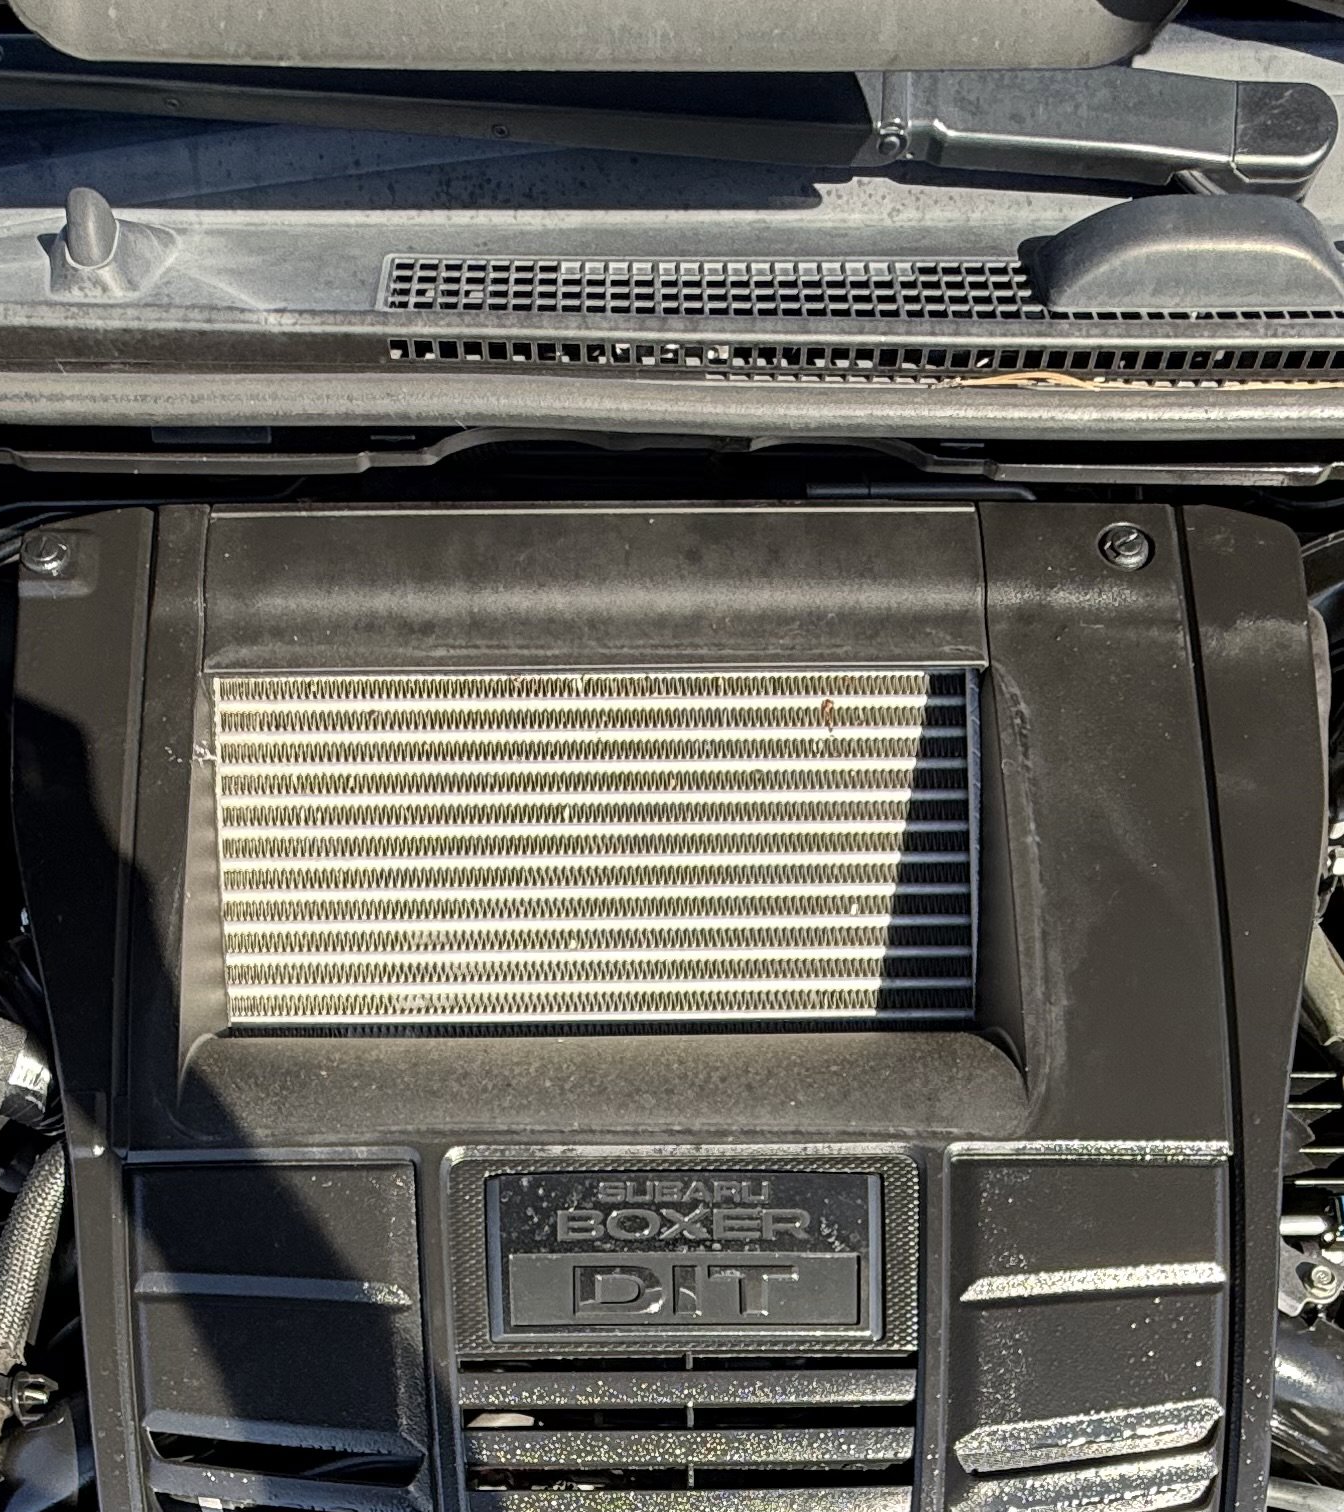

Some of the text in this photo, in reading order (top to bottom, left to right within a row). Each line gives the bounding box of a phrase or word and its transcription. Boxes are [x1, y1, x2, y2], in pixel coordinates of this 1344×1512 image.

[597, 1180, 771, 1204] SUBARU
[556, 1207, 811, 1242] BOXER
[572, 1263, 800, 1318] DIT
